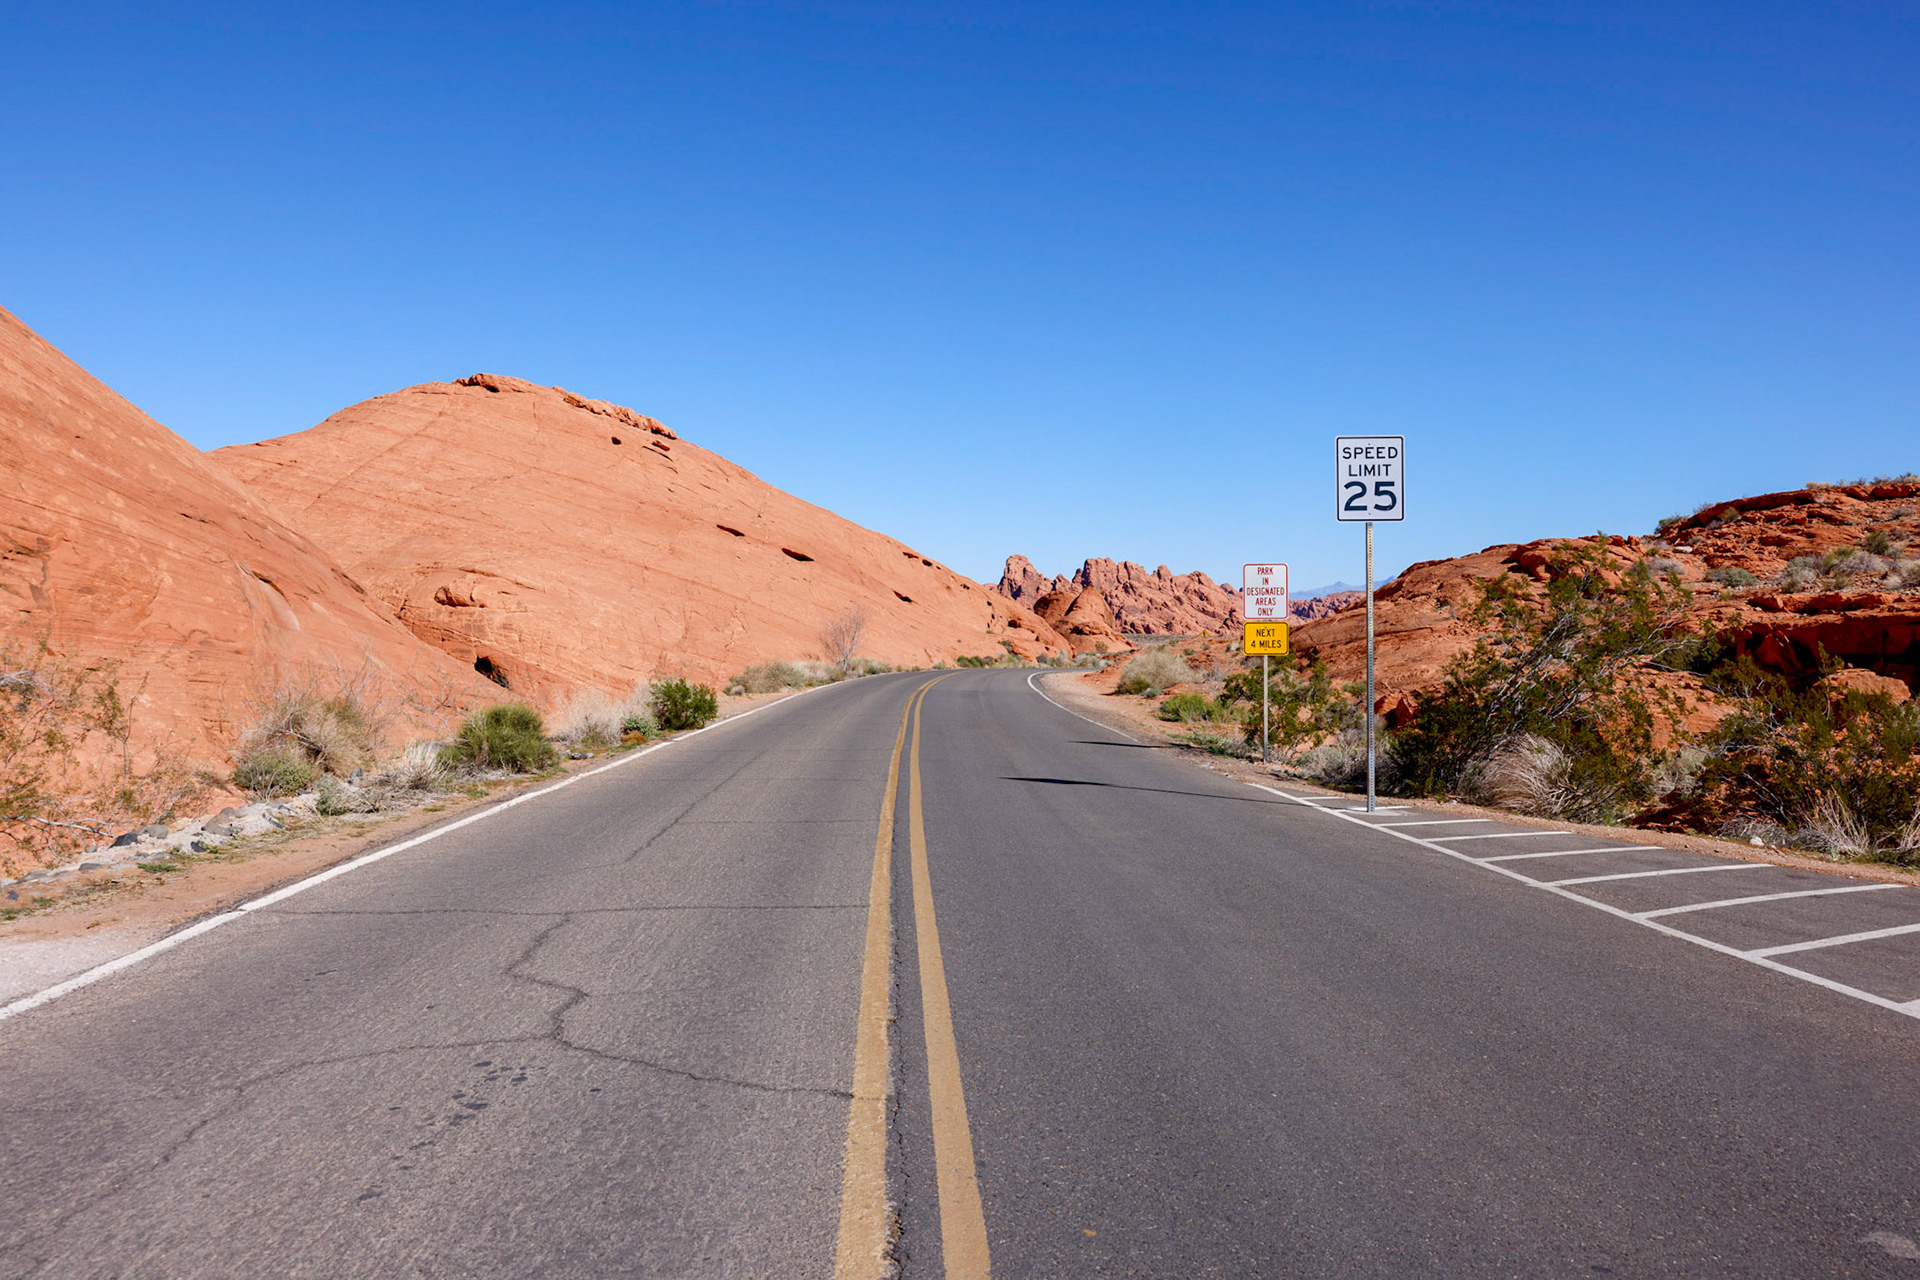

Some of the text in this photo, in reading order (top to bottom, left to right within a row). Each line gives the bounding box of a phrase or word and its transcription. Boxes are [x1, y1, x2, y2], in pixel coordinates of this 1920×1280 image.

[1342, 446, 1398, 460] SPEED
[1348, 463, 1392, 477] LIMIT
[1343, 481, 1397, 511] 25
[1257, 567, 1273, 575] PARK
[1262, 577, 1269, 585] IN
[1246, 587, 1285, 596] DESIGNATED
[1255, 597, 1277, 606] AREAS
[1257, 607, 1273, 616] ONLY
[1256, 628, 1275, 637] NEXT
[1250, 640, 1282, 648] 4 MILES
